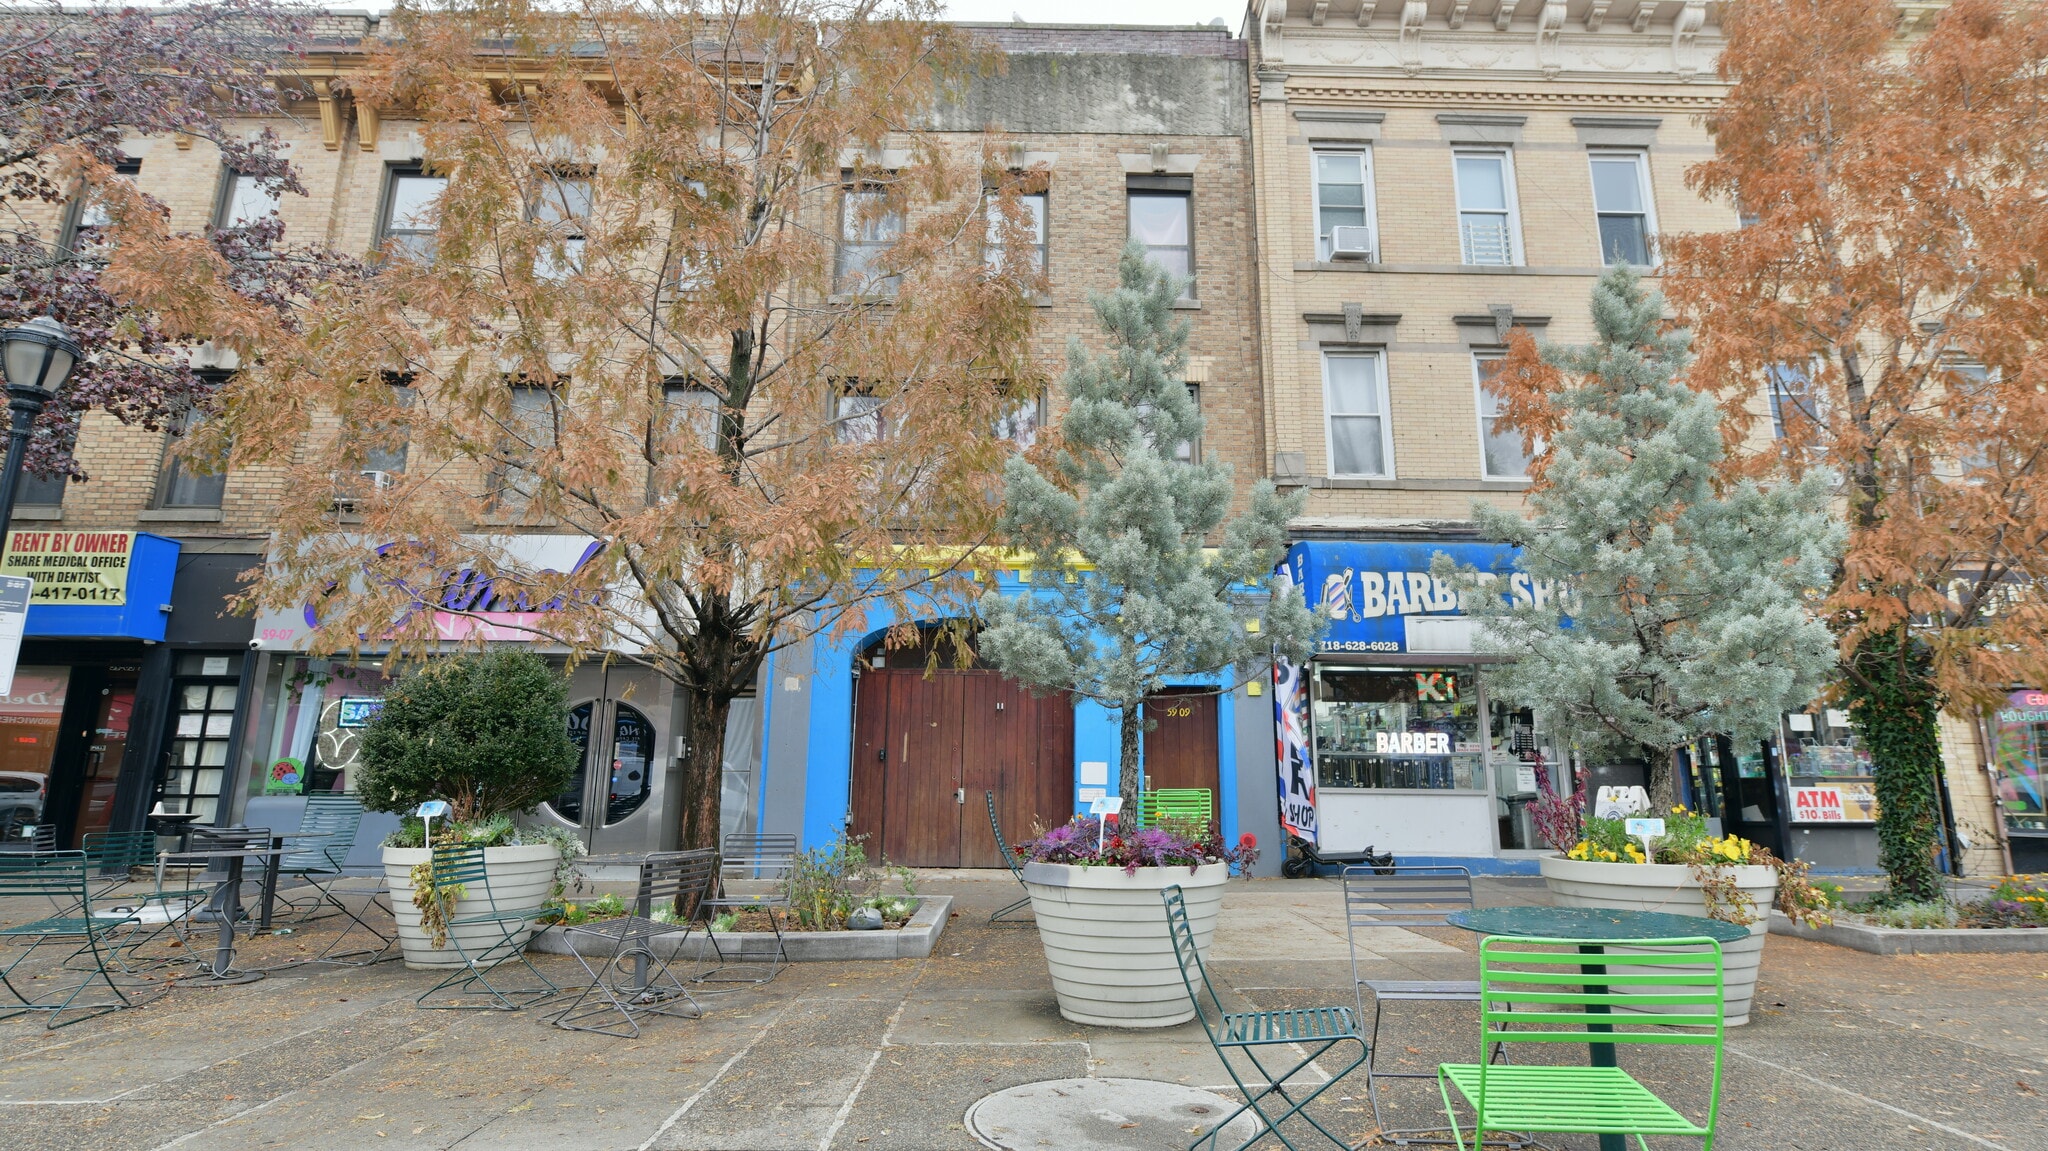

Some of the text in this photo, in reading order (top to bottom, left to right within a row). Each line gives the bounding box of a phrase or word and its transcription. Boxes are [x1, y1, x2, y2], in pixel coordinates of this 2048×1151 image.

[11, 533, 128, 553] RENT BY OWNER
[7, 555, 126, 567] SHARE MEDICAL OFFICE
[27, 571, 101, 583] WITH DENTIST
[261, 629, 294, 640] 59-07
[1321, 641, 1399, 651] 718-628-6028
[1167, 708, 1190, 717] 59 09
[1376, 732, 1450, 753] BARBER
[1797, 791, 1840, 808] ATM
[1289, 803, 1314, 827] SHOP
[1823, 811, 1841, 820] Bills
